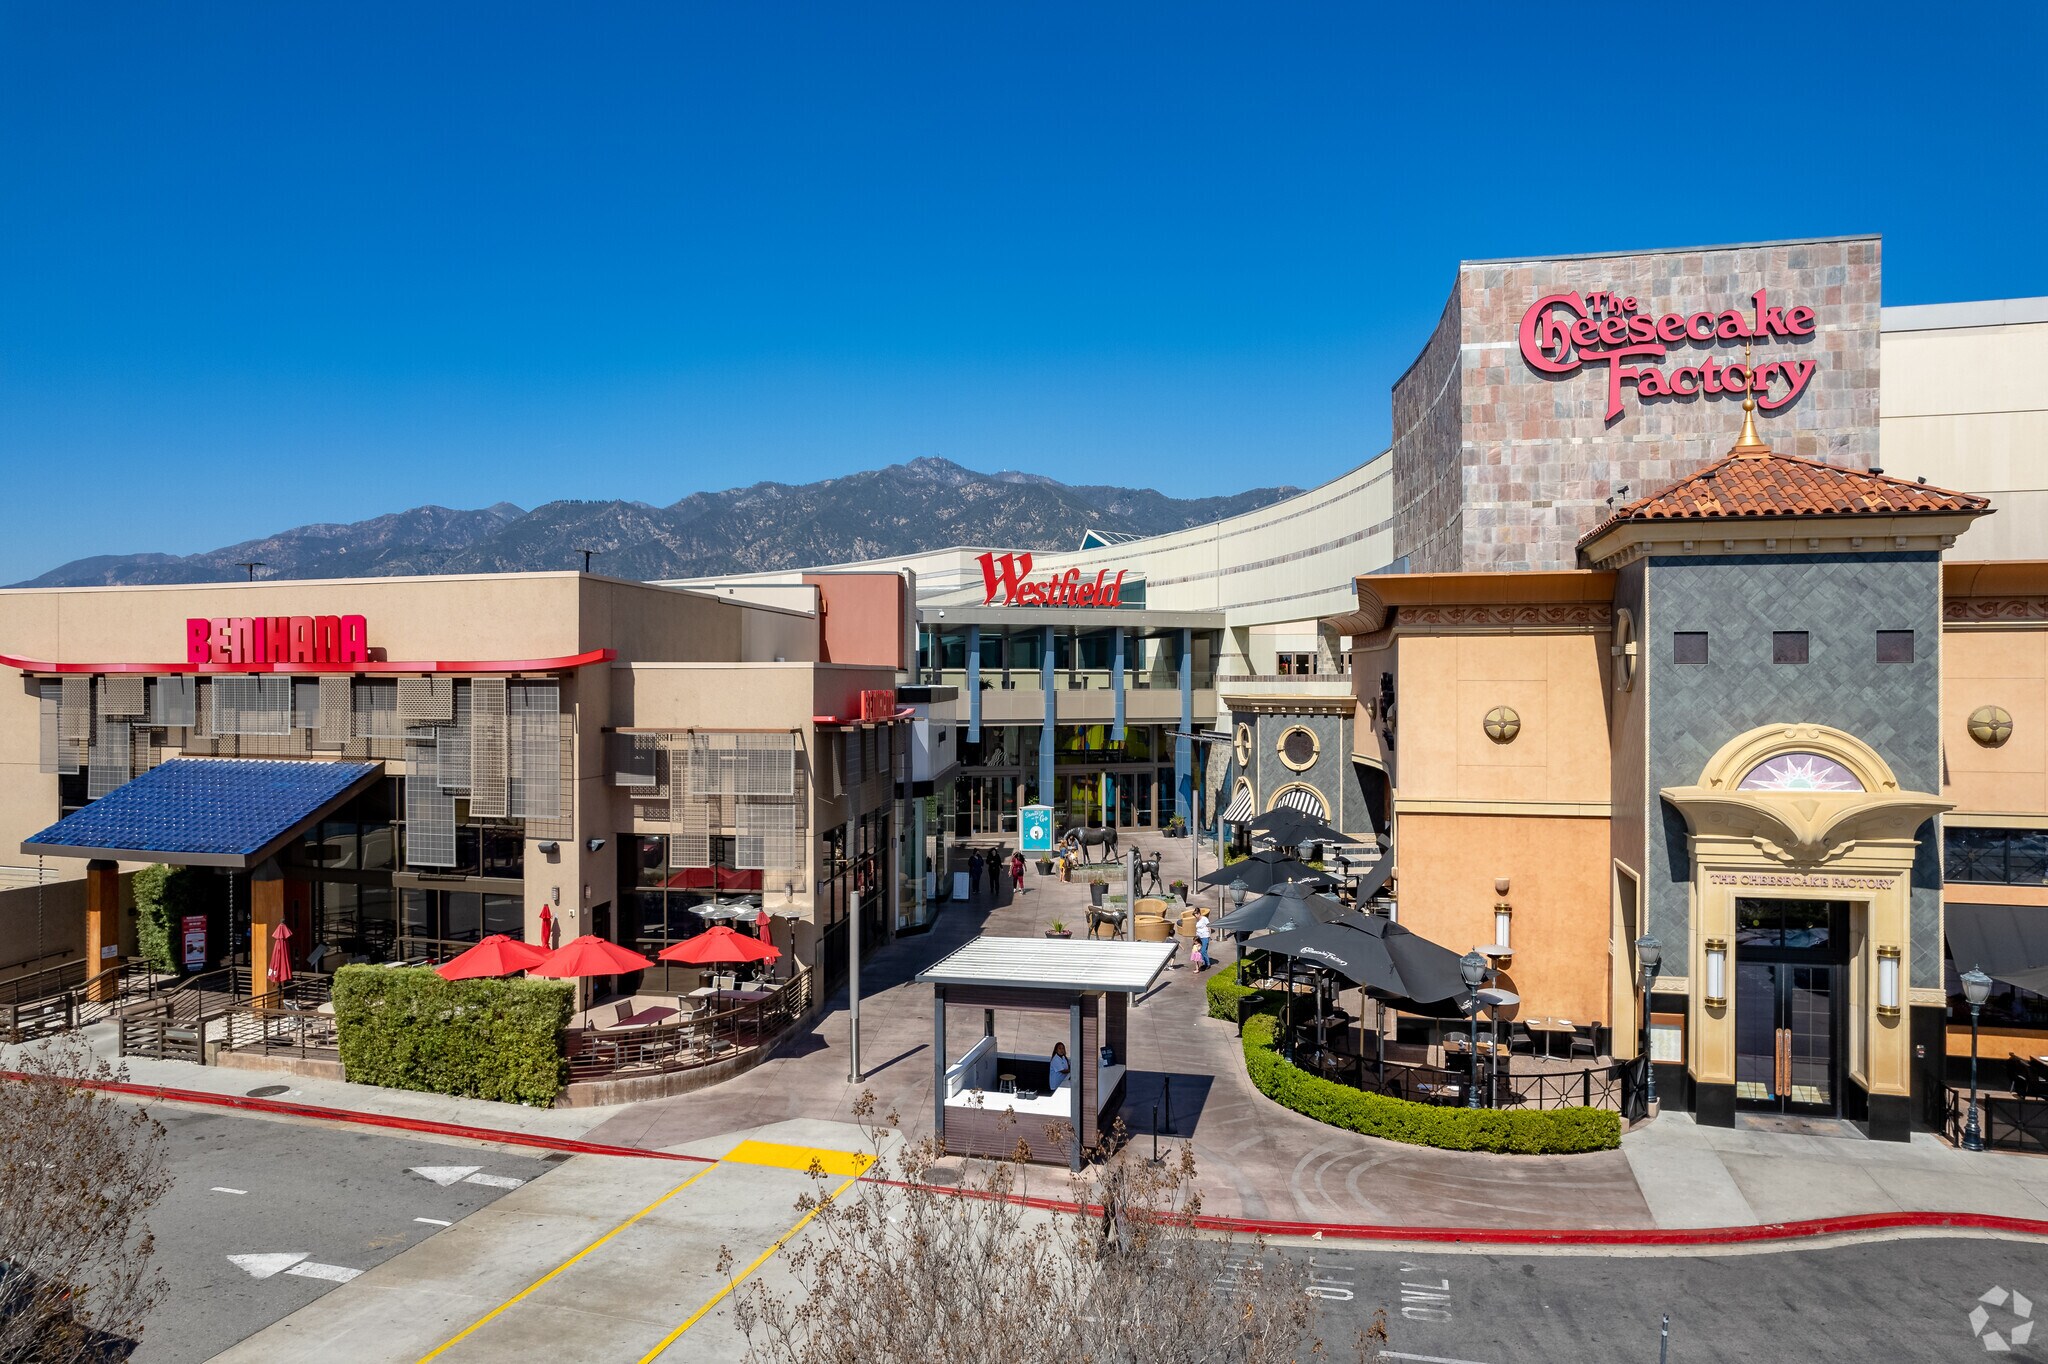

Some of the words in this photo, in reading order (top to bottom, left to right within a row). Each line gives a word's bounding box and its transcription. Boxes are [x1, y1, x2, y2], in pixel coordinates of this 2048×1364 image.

[1519, 288, 1817, 373] Cheesecake
[1586, 290, 1638, 317] The
[1578, 343, 1817, 421] Factory
[974, 552, 1129, 607] Westfield
[186, 614, 368, 664] BENIHANA
[1710, 874, 1737, 885] THE
[1740, 875, 1829, 888] CHEESECAKE
[1832, 877, 1895, 891] FACTORY
[1399, 1259, 1452, 1323] ONLY
